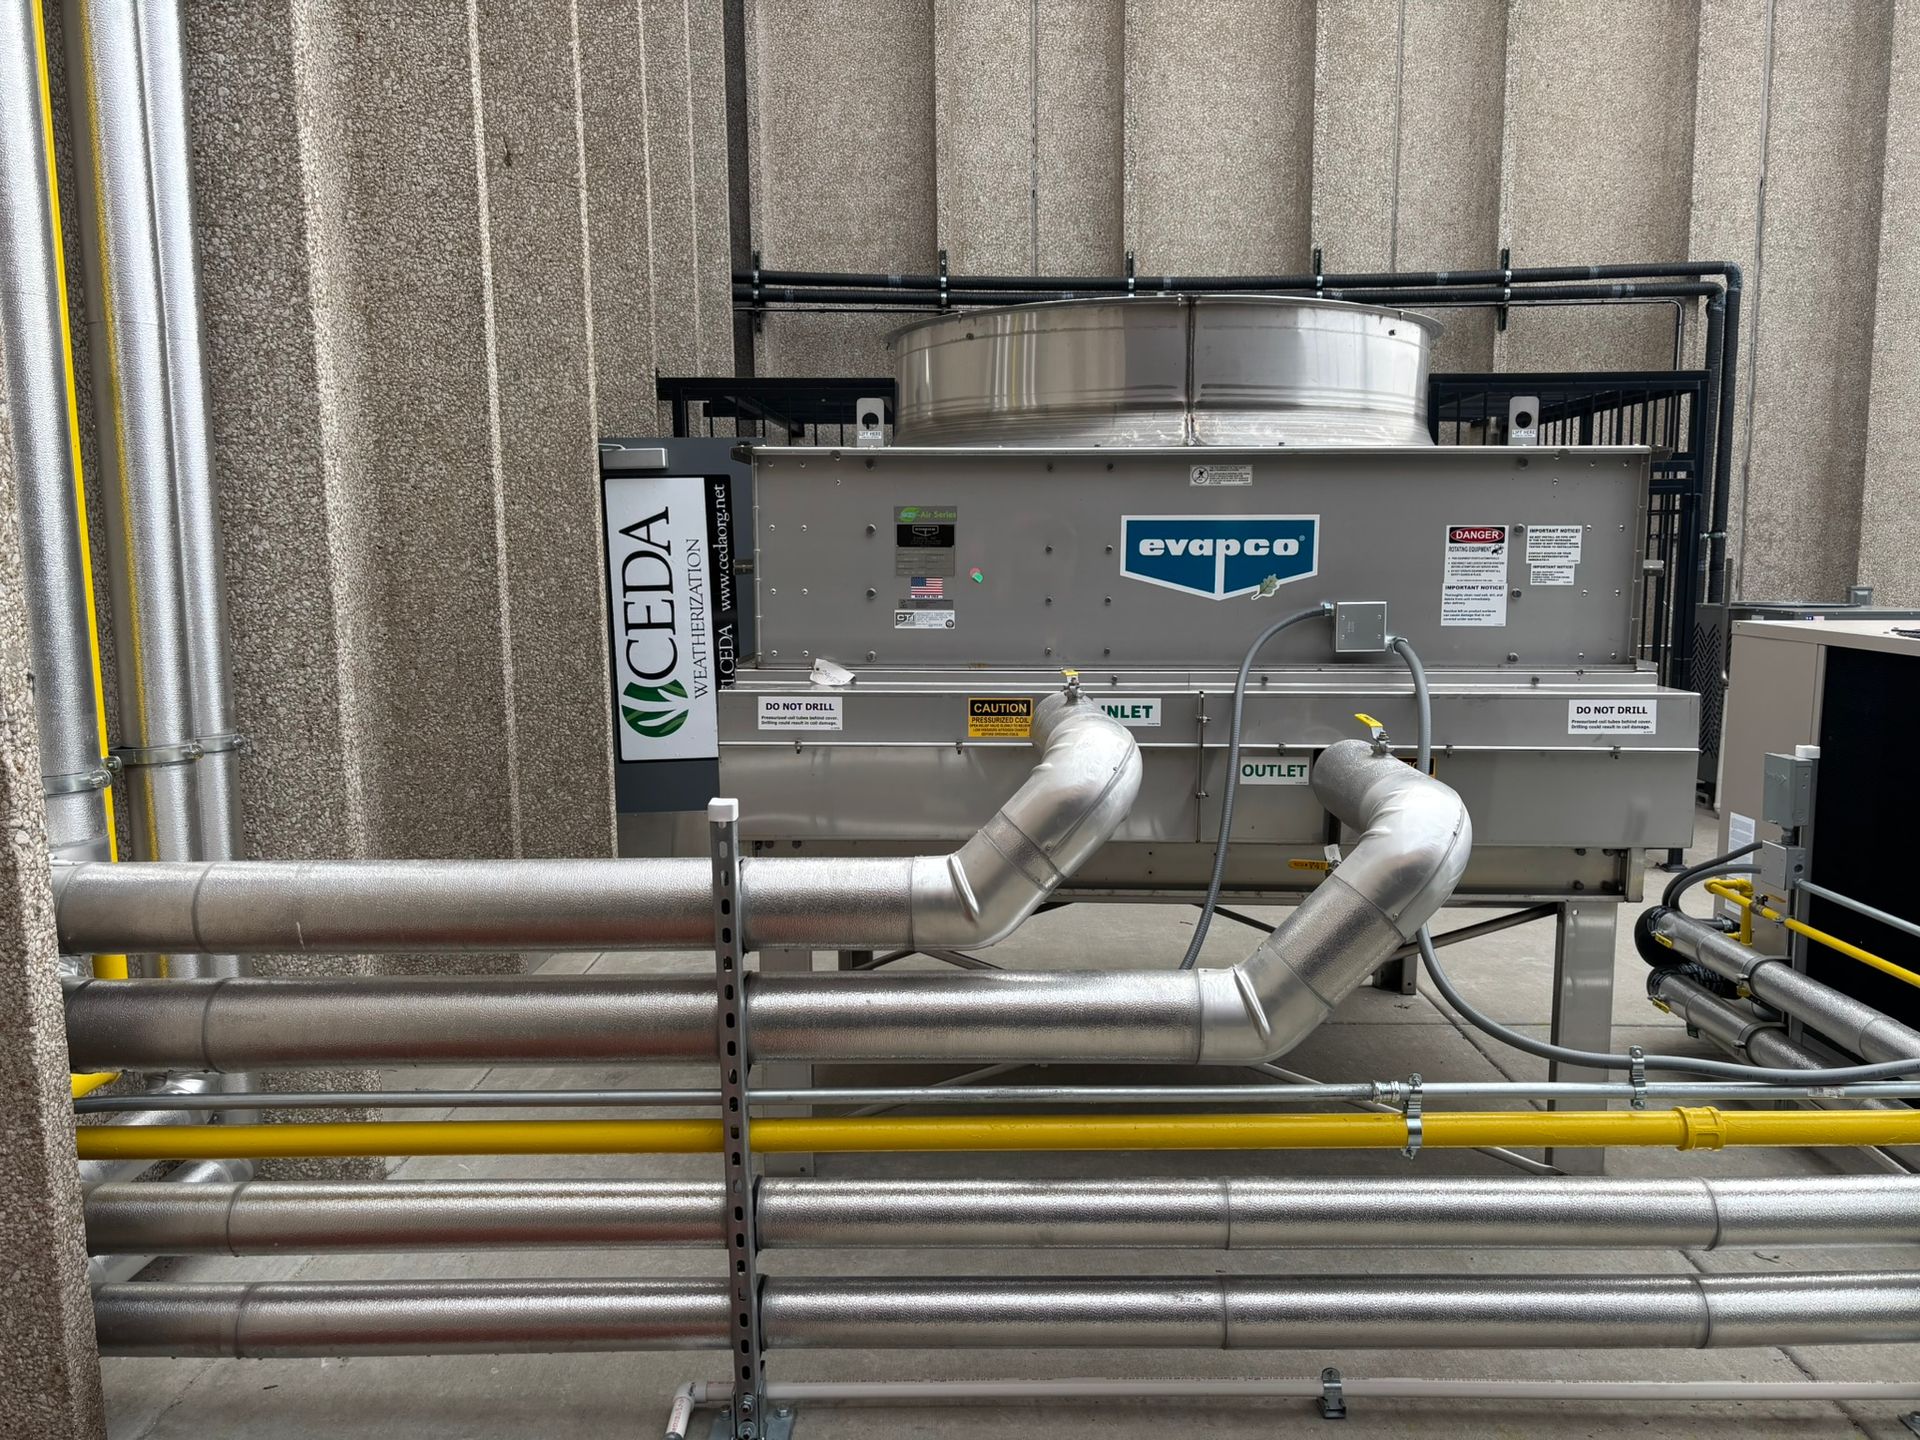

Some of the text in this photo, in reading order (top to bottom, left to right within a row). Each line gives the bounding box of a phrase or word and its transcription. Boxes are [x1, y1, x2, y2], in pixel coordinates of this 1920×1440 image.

[1455, 530, 1500, 540] DANGER
[1138, 538, 1299, 557] evapco
[619, 506, 678, 680] CEDA
[712, 484, 735, 689] 1.CEDA www.cedaorg.net
[686, 539, 708, 699] WEATHERIZATION
[766, 703, 834, 711] DO NOT DRILL
[974, 703, 1027, 713] CAUTION
[1576, 706, 1648, 714] DO NOT DRILL
[1242, 764, 1307, 777] OUTLET
